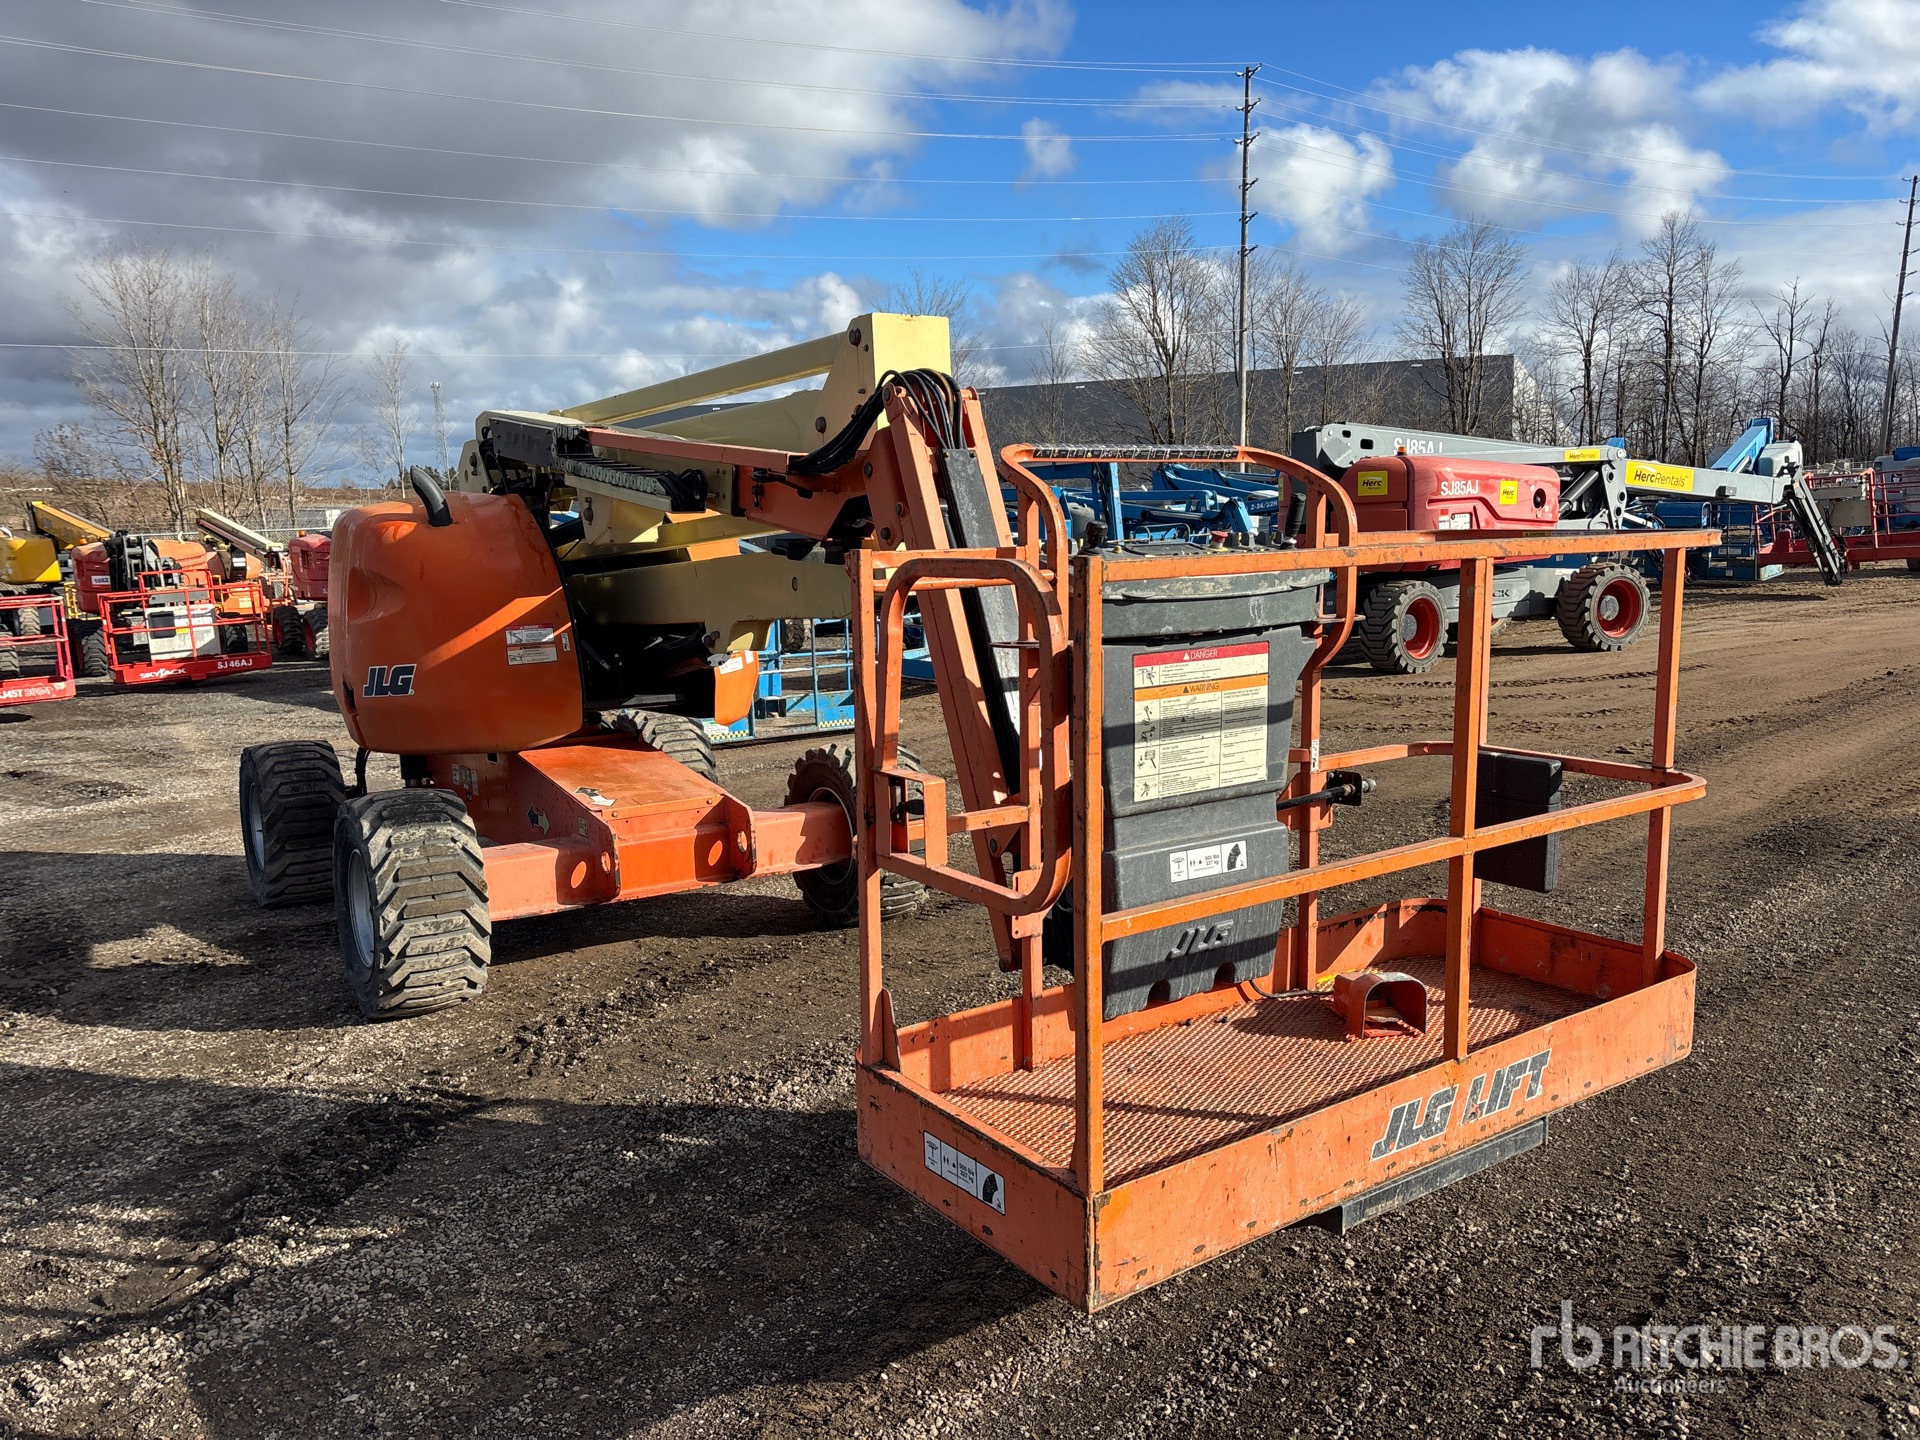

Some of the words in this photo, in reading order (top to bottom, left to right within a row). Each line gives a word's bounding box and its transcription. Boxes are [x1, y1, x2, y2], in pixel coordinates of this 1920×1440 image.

[1440, 479, 1479, 496] SJ85AJ
[1190, 649, 1218, 660] DANGER
[362, 663, 417, 697] JLG
[1190, 682, 1220, 693] WARNING
[1165, 919, 1234, 959] JLG
[1370, 1084, 1459, 1162] JLG
[1461, 1048, 1552, 1127] LIFT
